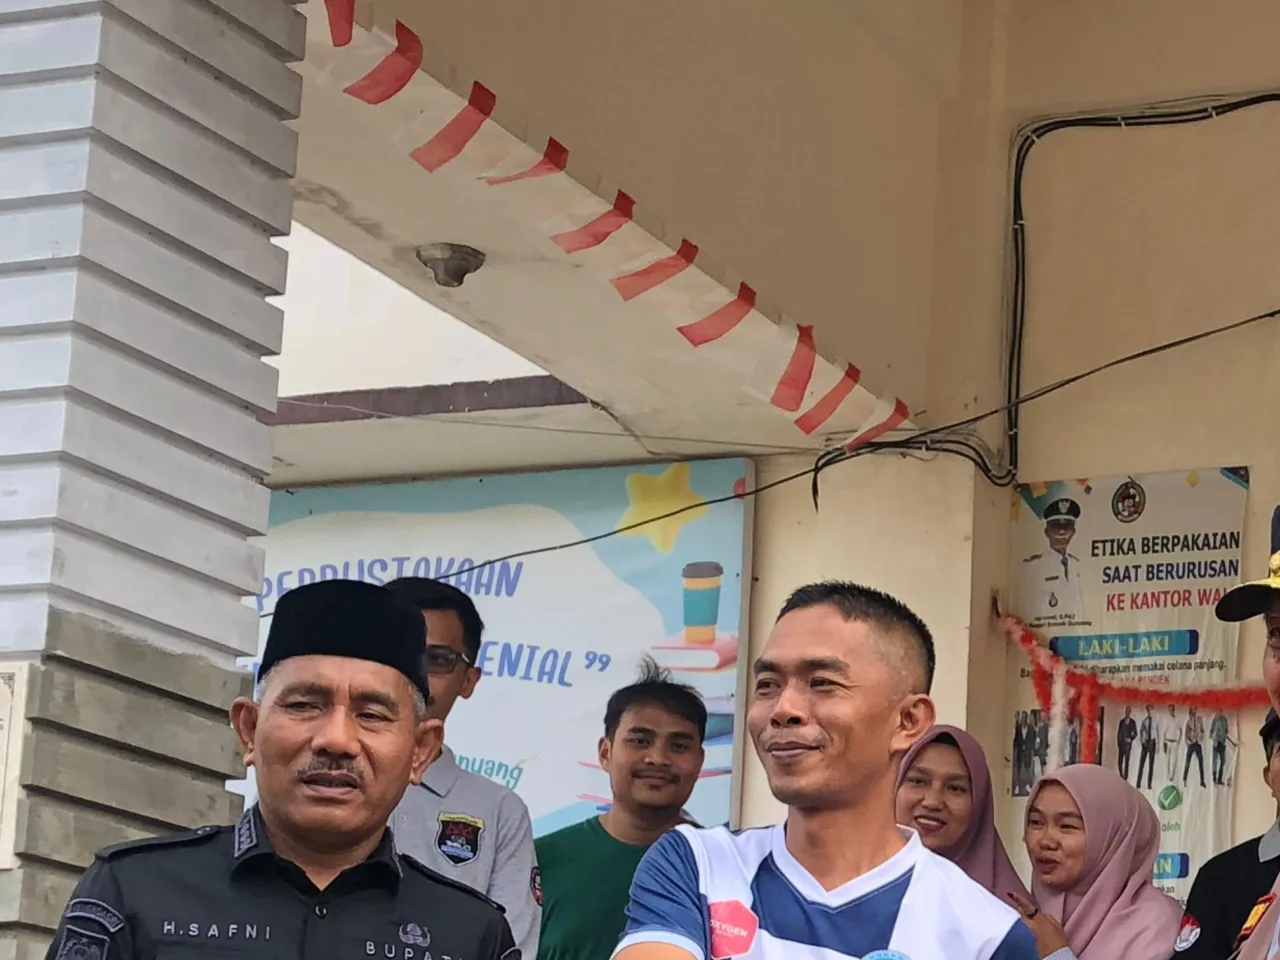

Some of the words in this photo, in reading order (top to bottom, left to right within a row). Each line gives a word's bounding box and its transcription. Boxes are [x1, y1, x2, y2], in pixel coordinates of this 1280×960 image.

[1091, 538, 1136, 557] ETIKA
[1141, 531, 1241, 554] BERPAKAIAN
[1102, 565, 1142, 584] SAAT
[1146, 559, 1239, 581] BERURUSAN
[1106, 593, 1126, 612] KE
[1130, 589, 1192, 610] KANTOR
[1197, 588, 1228, 607] WA
[1078, 635, 1170, 656] LAKI-LAKI
[1167, 660, 1192, 671] celana
[163, 921, 270, 940] H.SAFNI
